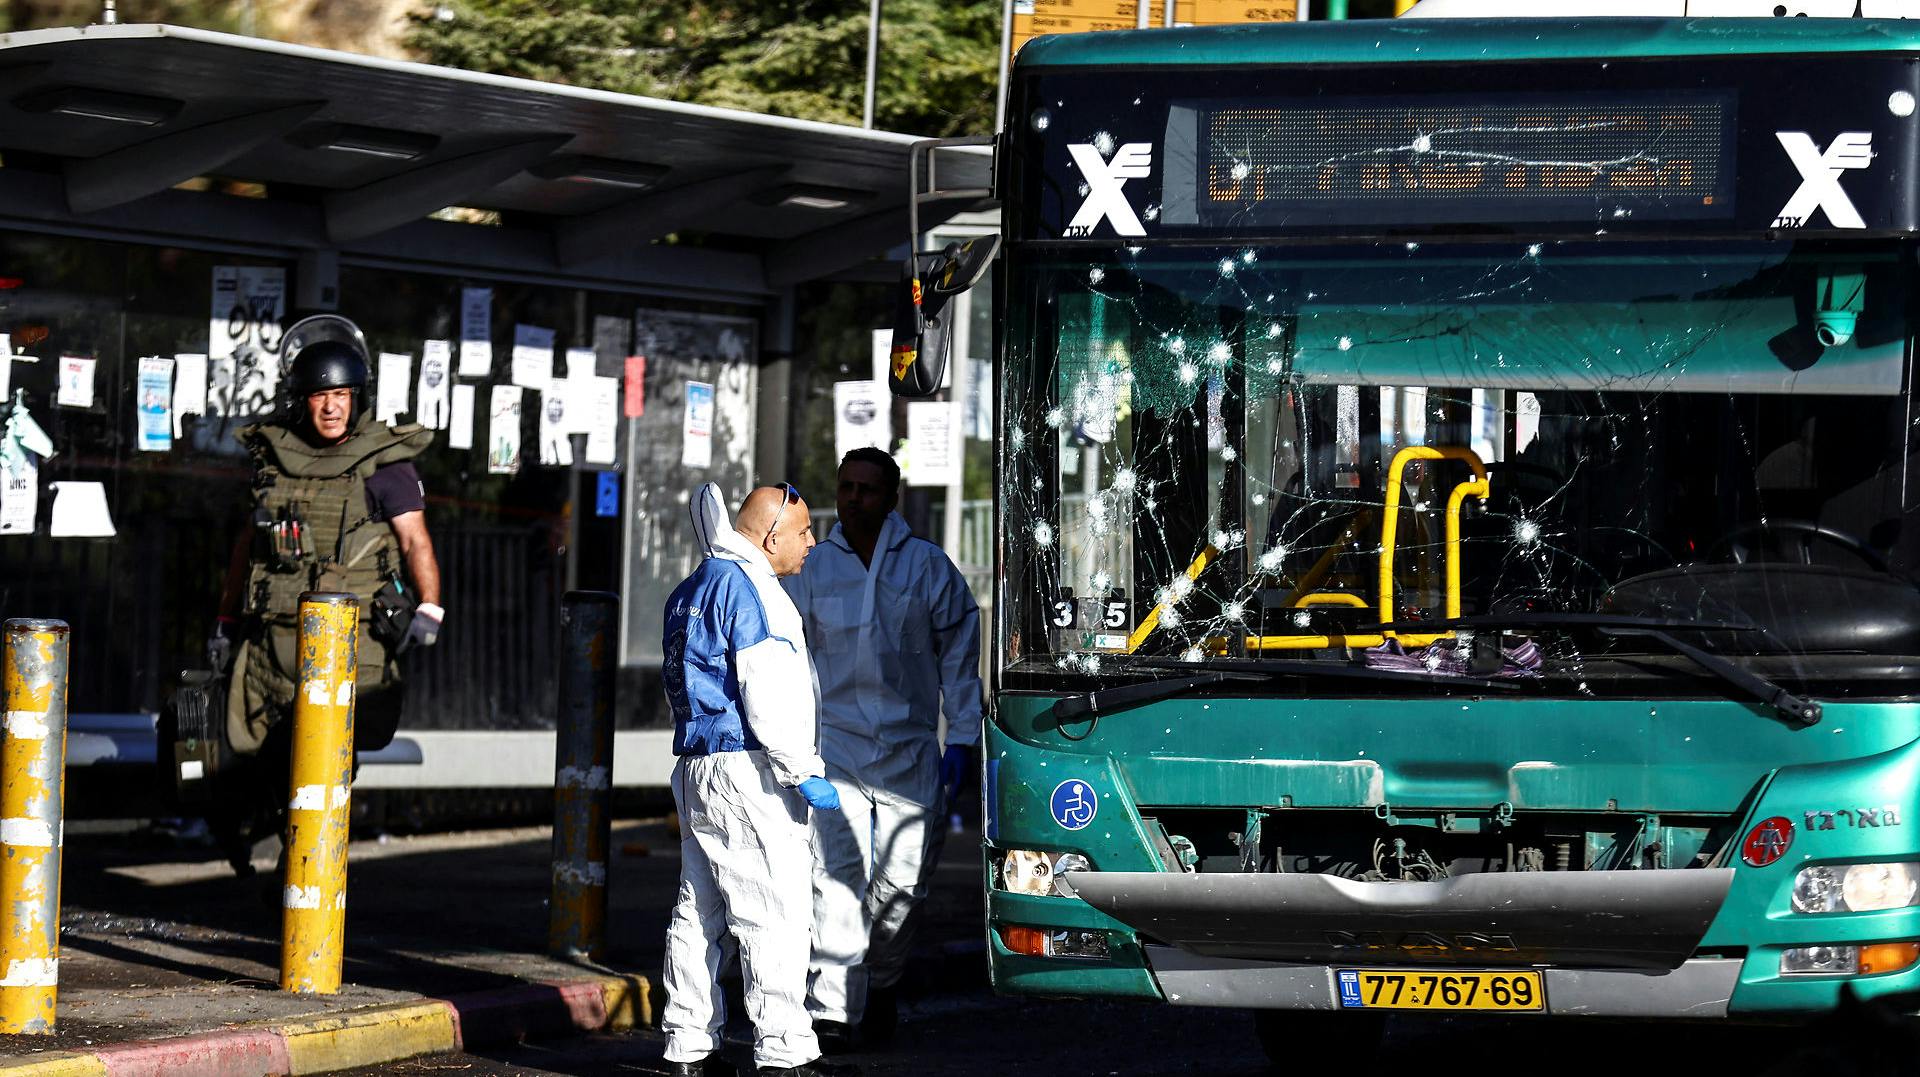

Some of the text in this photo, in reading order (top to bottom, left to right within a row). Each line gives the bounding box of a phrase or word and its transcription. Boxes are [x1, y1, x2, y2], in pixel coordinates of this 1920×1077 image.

[1053, 601, 1073, 627] 3
[1106, 602, 1126, 627] 5
[1344, 982, 1358, 996] IL
